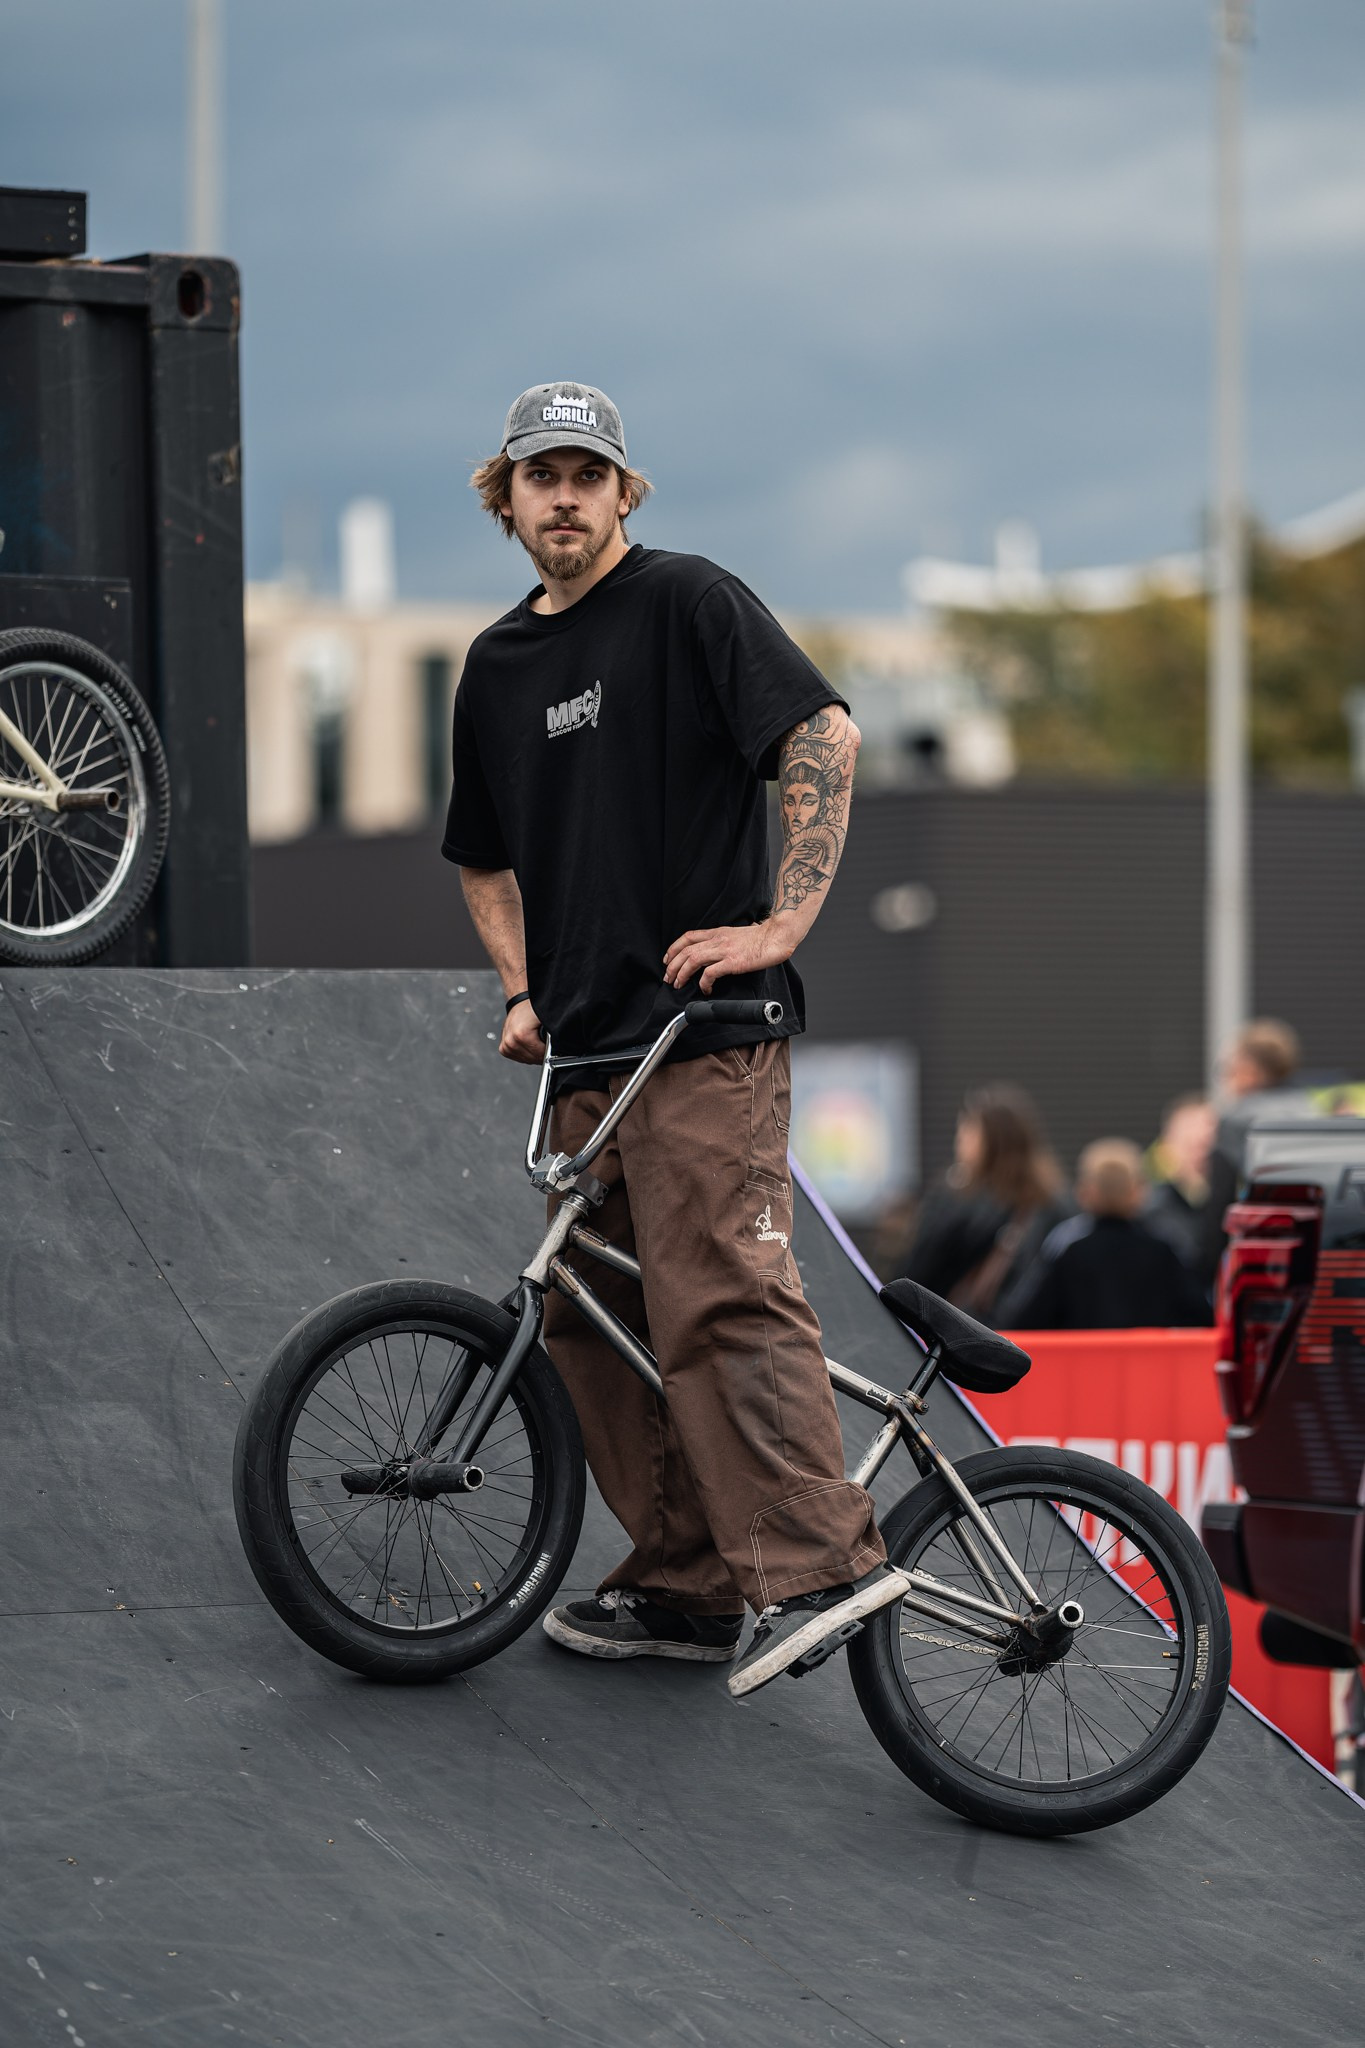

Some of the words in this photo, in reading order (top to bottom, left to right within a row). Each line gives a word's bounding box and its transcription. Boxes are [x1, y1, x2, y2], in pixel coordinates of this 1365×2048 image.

[542, 406, 598, 428] GORILLA
[546, 689, 594, 732] MFC
[548, 726, 572, 739] MOSCOW
[516, 1559, 551, 1604] WOLFGRIP
[1195, 1631, 1209, 1682] WOLFGRIP
